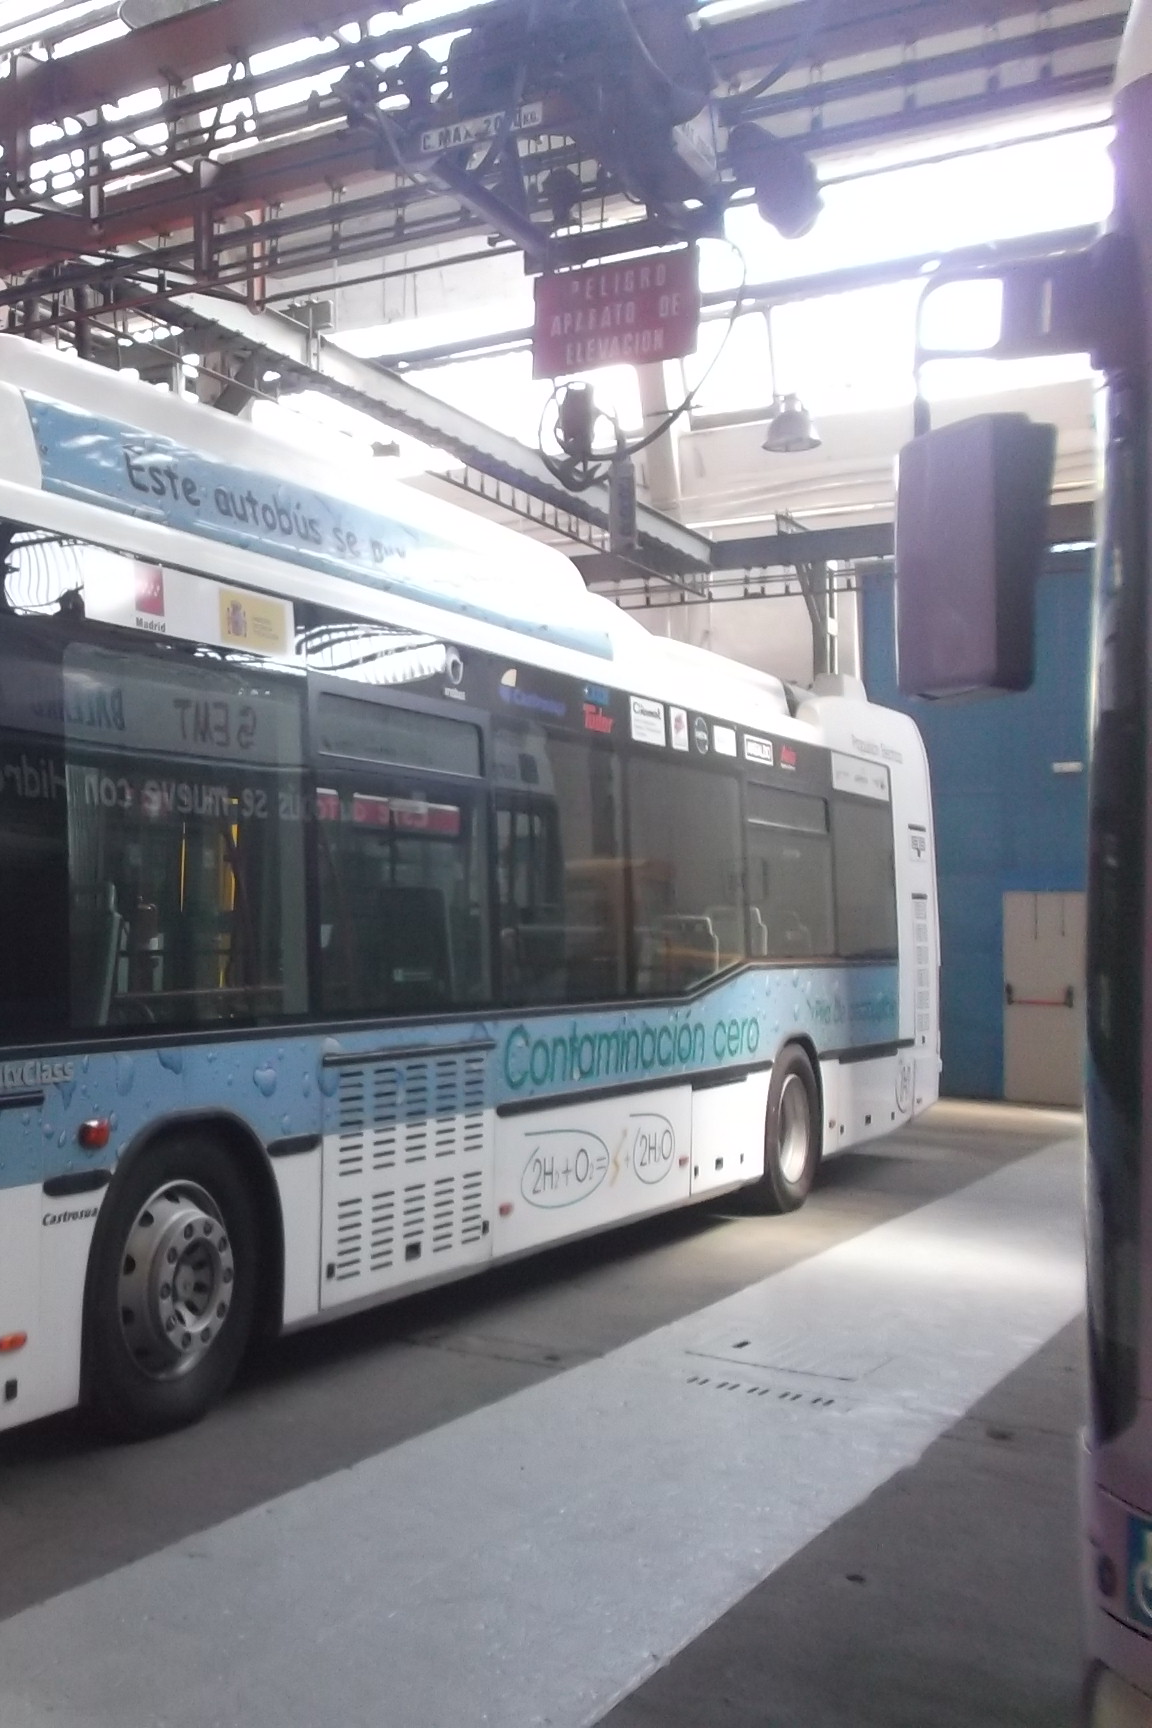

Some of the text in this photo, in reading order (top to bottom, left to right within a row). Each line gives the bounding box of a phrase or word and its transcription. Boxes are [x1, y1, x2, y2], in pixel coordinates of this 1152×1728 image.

[572, 263, 667, 300] PELIGRO
[550, 292, 681, 337] APARATO DE
[565, 328, 665, 366] ELEVACION
[121, 444, 201, 507] Este
[214, 482, 322, 545] autobús
[135, 615, 167, 633] Madrid
[503, 1010, 760, 1090] Contaminación cero
[41, 1207, 99, 1227] Castrosua
